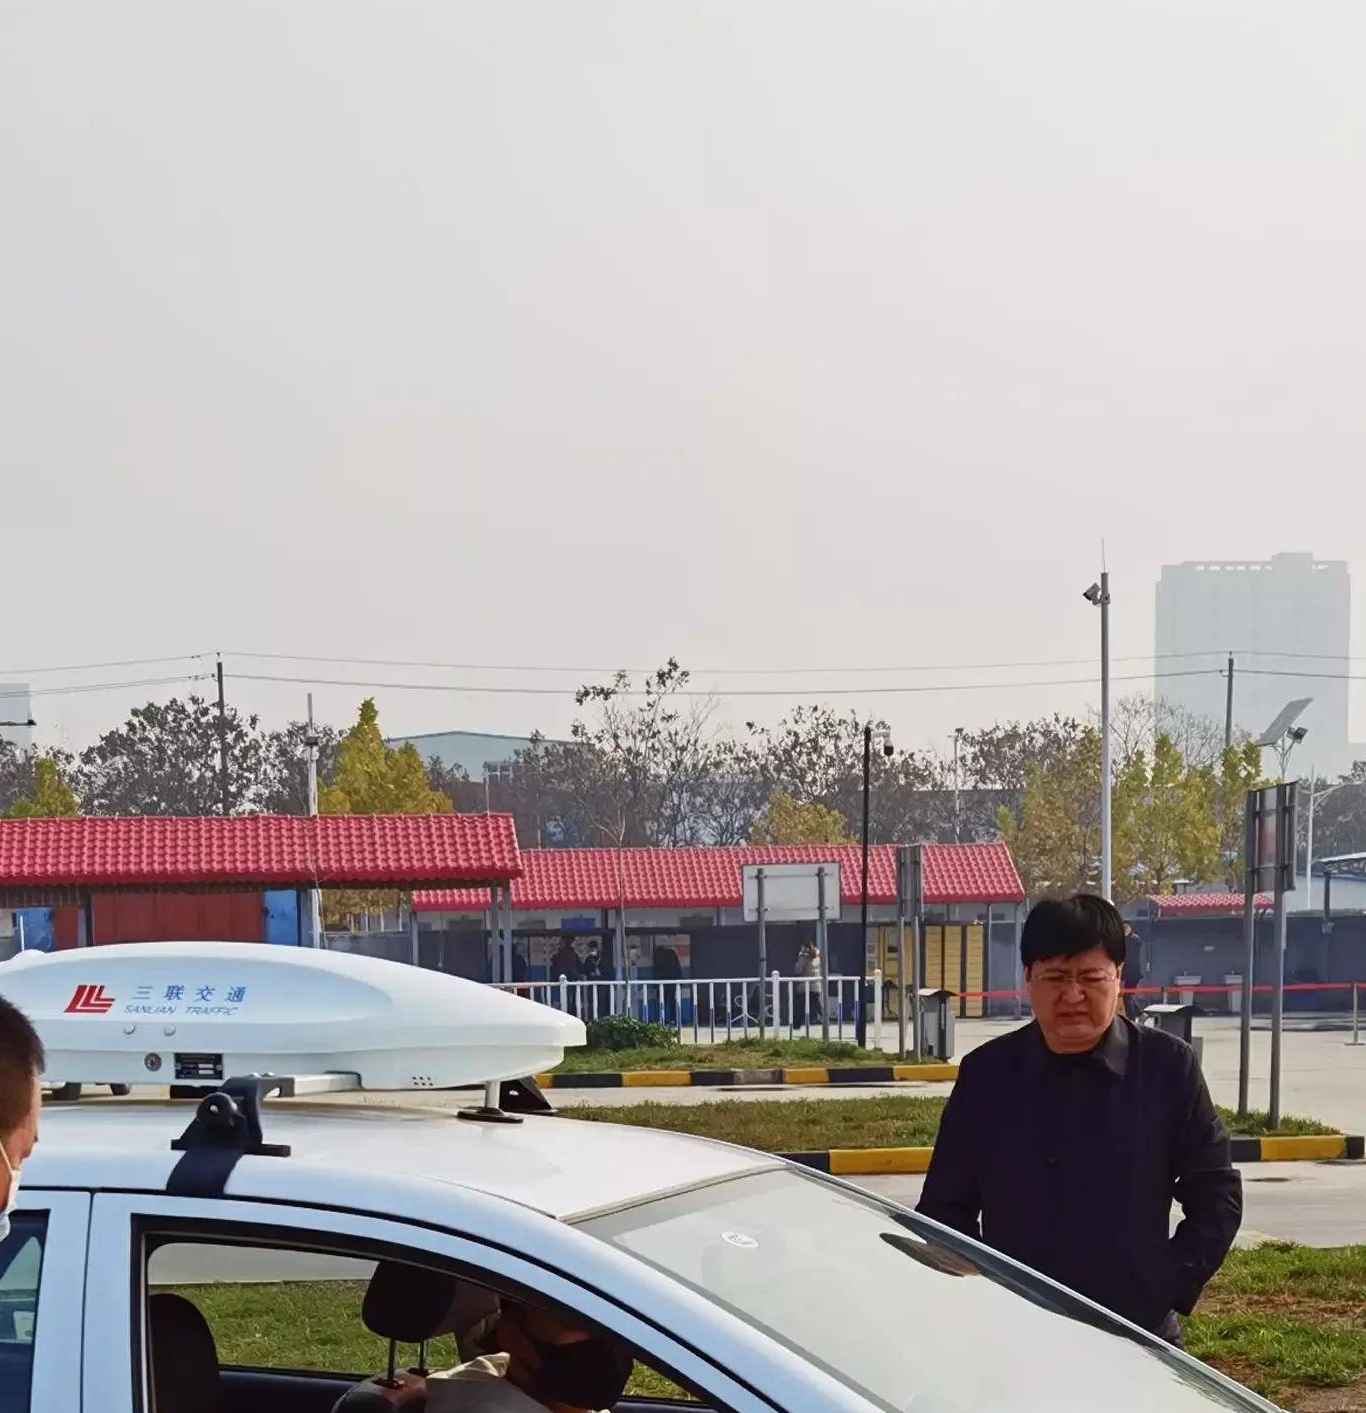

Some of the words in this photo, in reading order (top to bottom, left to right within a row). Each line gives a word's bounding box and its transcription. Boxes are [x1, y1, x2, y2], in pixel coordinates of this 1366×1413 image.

[131, 985, 246, 1003] 三联交通
[124, 1004, 177, 1014] SANLIAN
[185, 1006, 239, 1016] TRAFFIC
